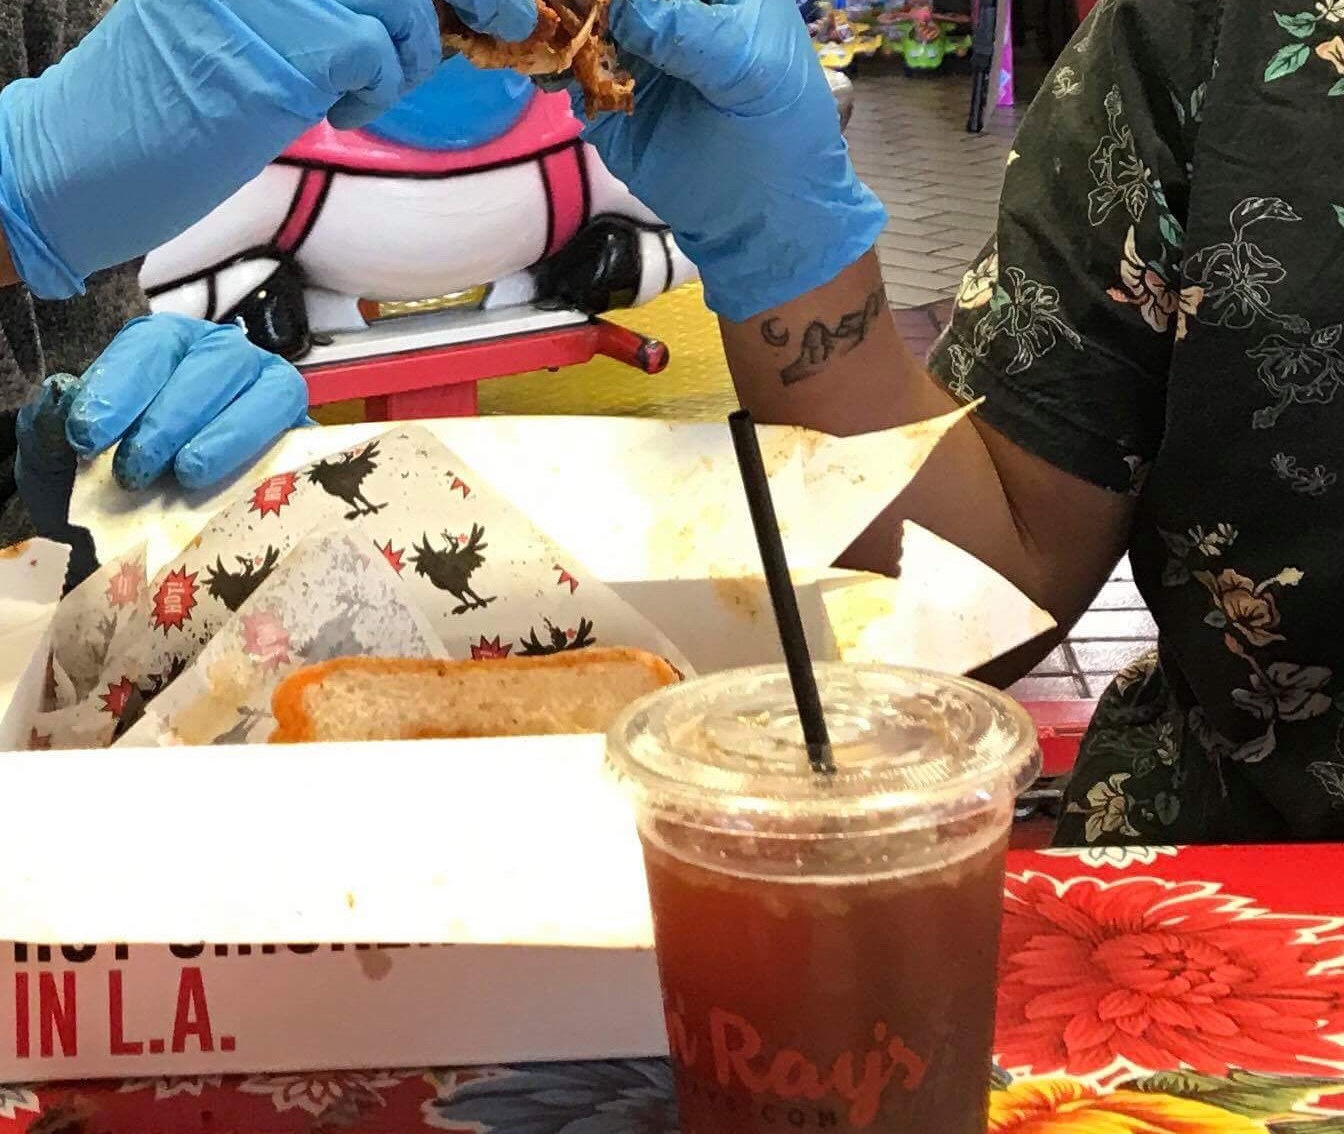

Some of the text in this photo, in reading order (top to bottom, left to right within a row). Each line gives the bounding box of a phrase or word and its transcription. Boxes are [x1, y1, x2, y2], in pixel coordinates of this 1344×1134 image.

[163, 581, 185, 615] HOT!
[15, 966, 237, 1058] IN L.A.
[708, 1005, 928, 1126] Ray's
